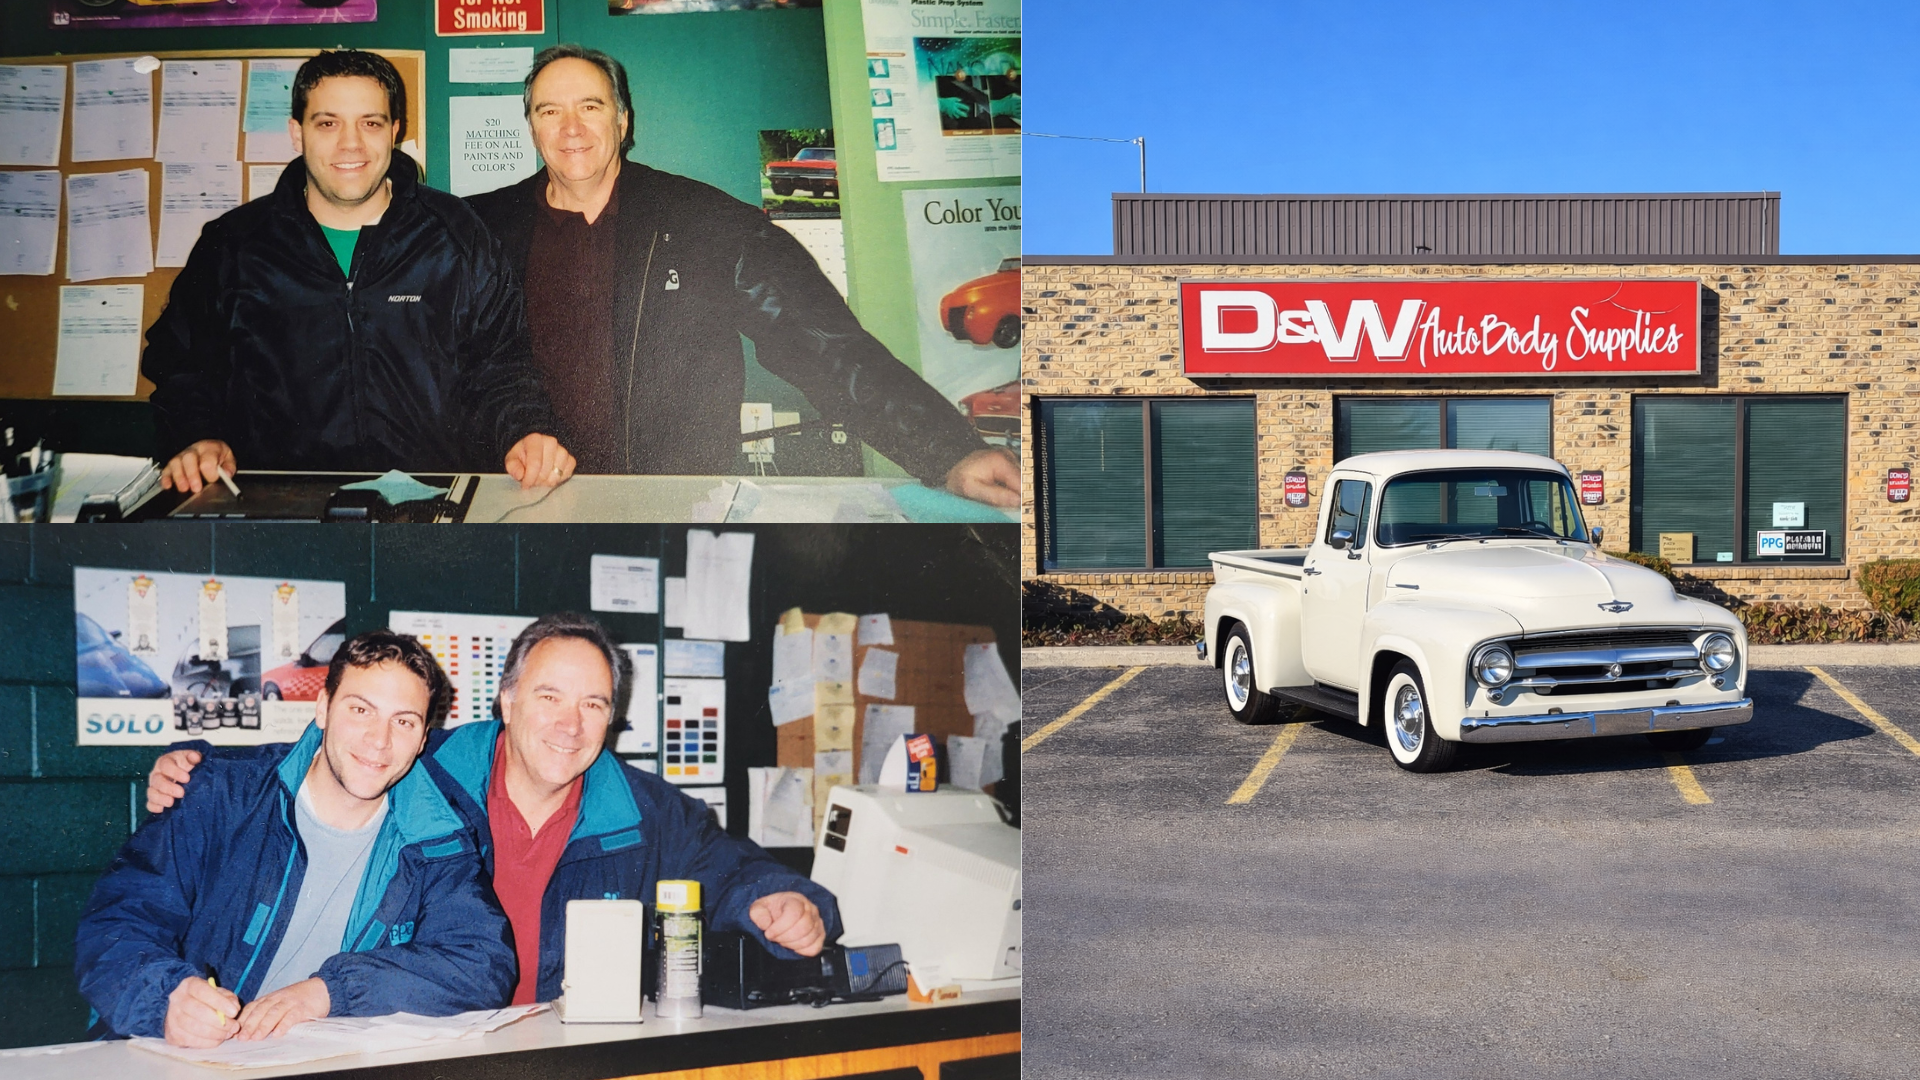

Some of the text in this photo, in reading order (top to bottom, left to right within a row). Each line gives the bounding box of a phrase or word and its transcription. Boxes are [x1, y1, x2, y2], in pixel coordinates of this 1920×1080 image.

[453, 6, 527, 31] Smoking
[911, 9, 971, 33] Simple.
[466, 129, 520, 139] MATCHING
[465, 140, 522, 149] FEE ON ALL
[464, 151, 524, 161] PAINTS AND
[471, 163, 516, 172] COLOR'S
[924, 199, 982, 225] Color
[1200, 290, 1427, 362] D&W
[1566, 306, 1684, 361] Supplies
[1761, 537, 1783, 549] PPG
[85, 713, 164, 734] SOLO
